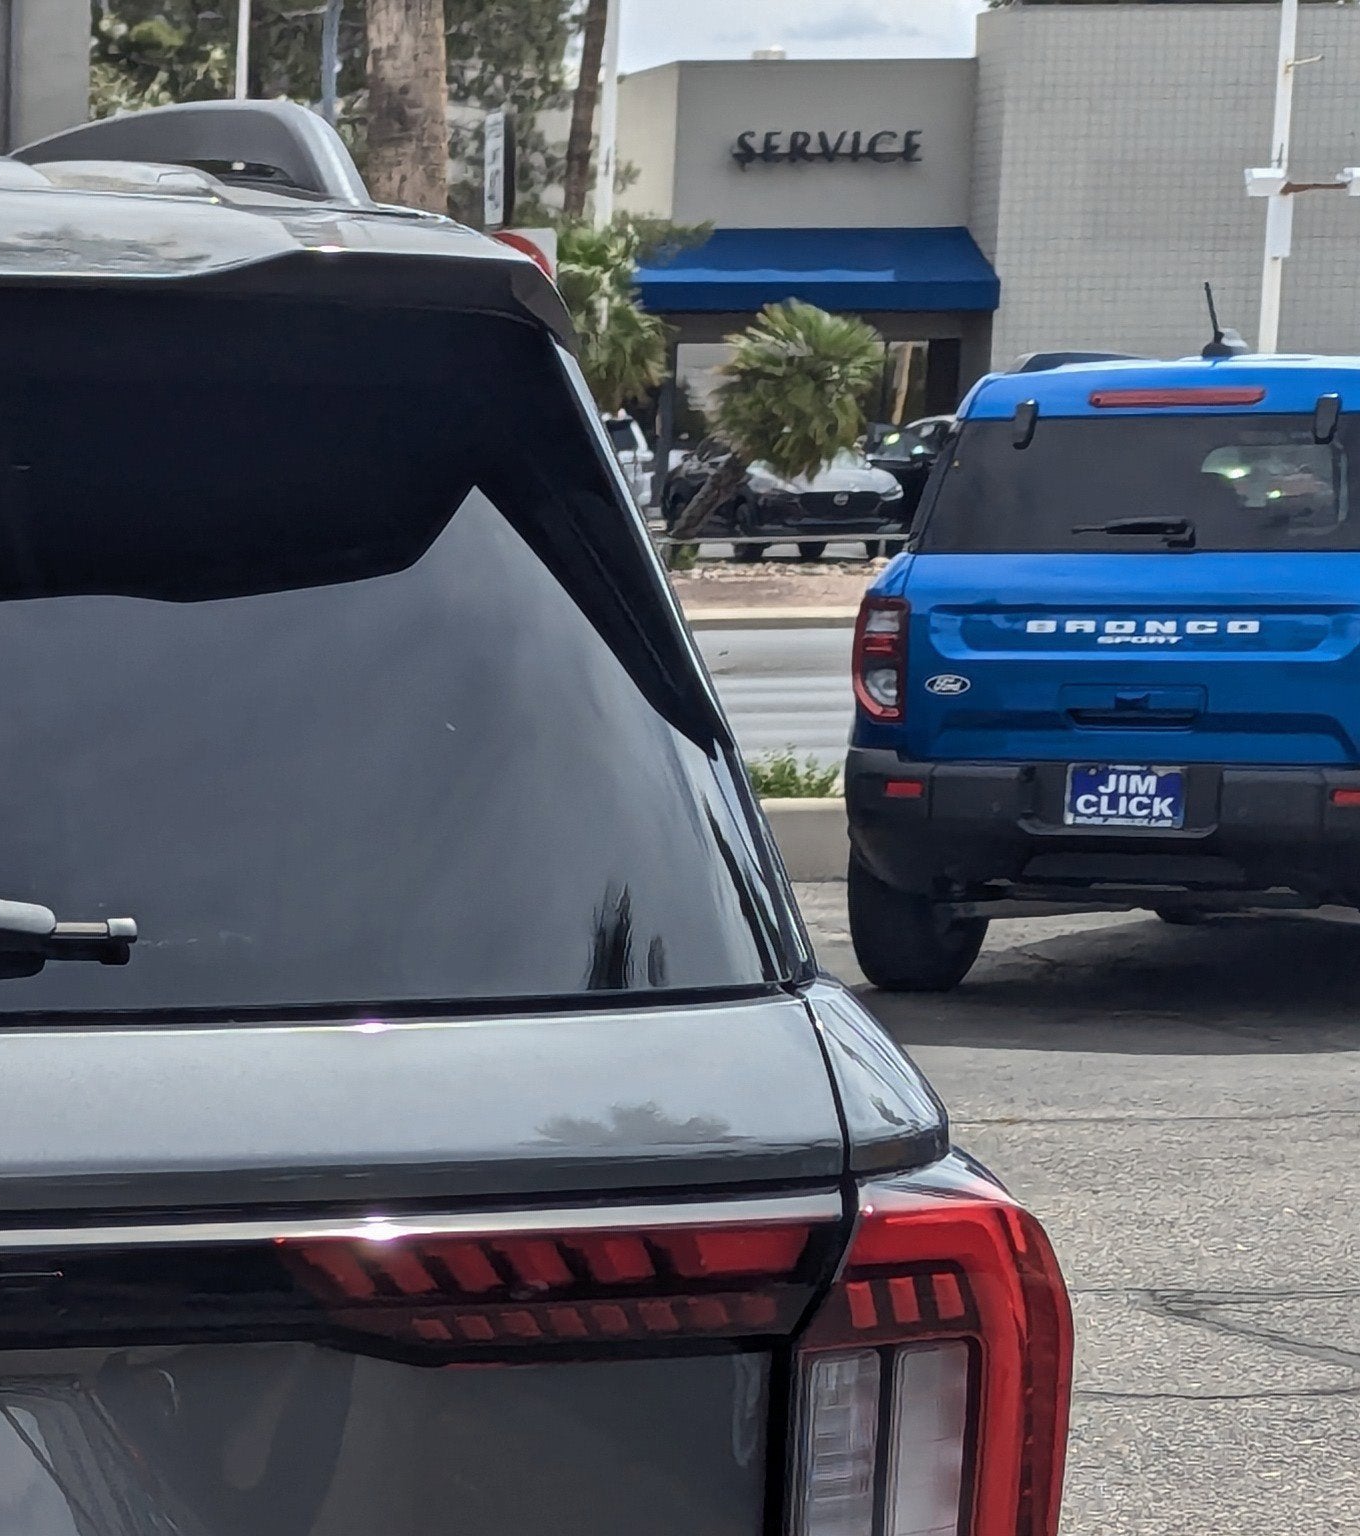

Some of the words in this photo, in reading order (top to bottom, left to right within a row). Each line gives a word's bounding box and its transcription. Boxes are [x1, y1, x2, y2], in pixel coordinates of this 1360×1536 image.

[734, 130, 923, 163] SERVICE
[1026, 620, 1260, 633] BRONCO
[1097, 635, 1182, 645] SPORT
[1098, 774, 1157, 795] JIM
[1076, 794, 1174, 817] CLICK
